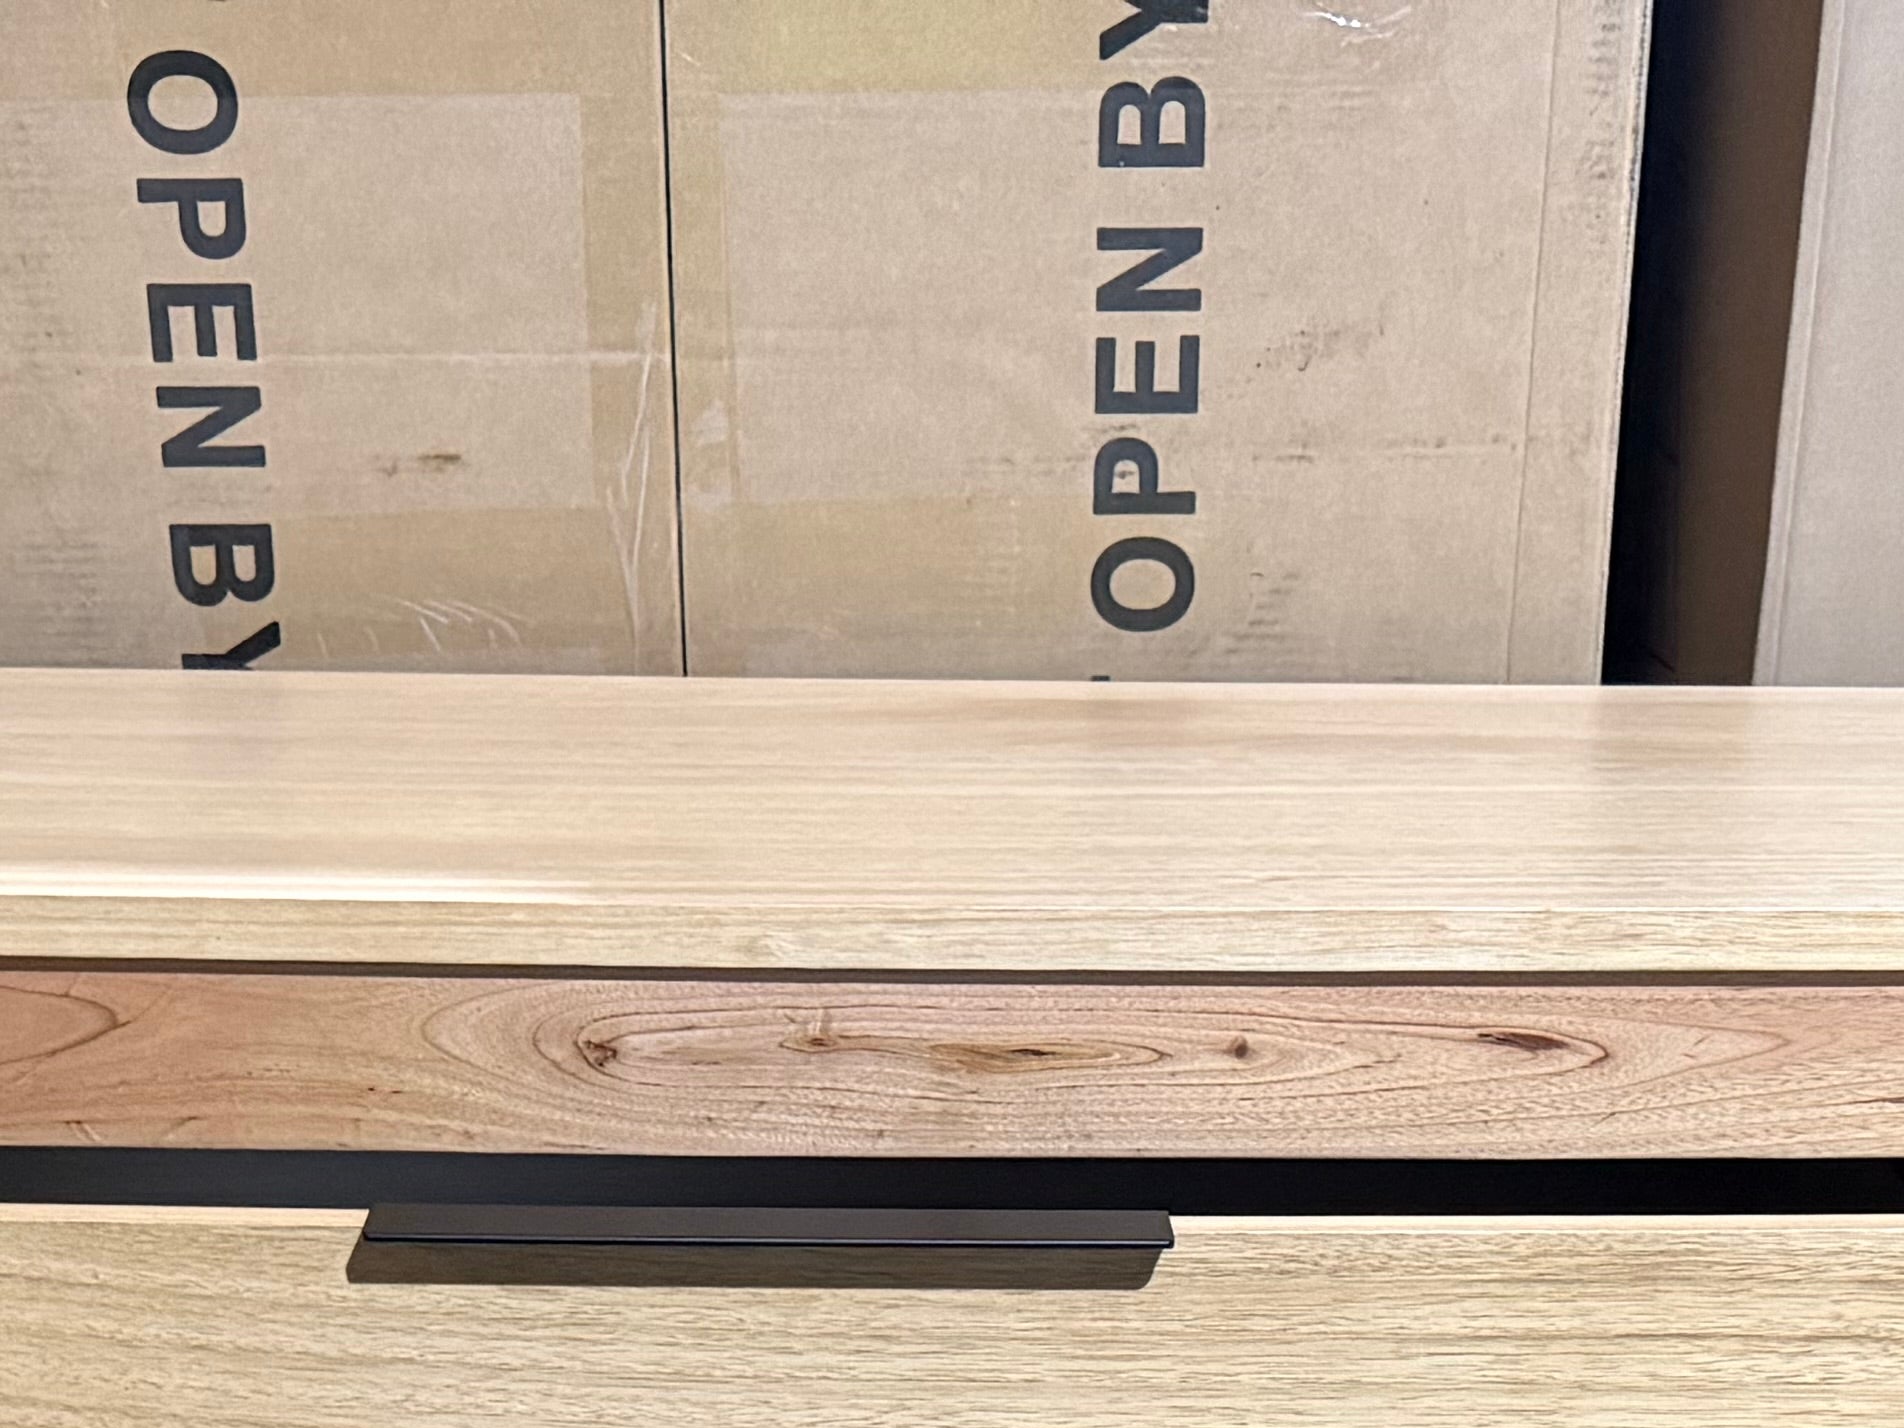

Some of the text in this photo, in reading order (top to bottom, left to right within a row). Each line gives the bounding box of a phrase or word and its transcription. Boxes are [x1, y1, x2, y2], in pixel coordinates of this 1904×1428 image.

[125, 48, 267, 468] OPEN
[1090, 0, 1209, 633] OPEN BY
